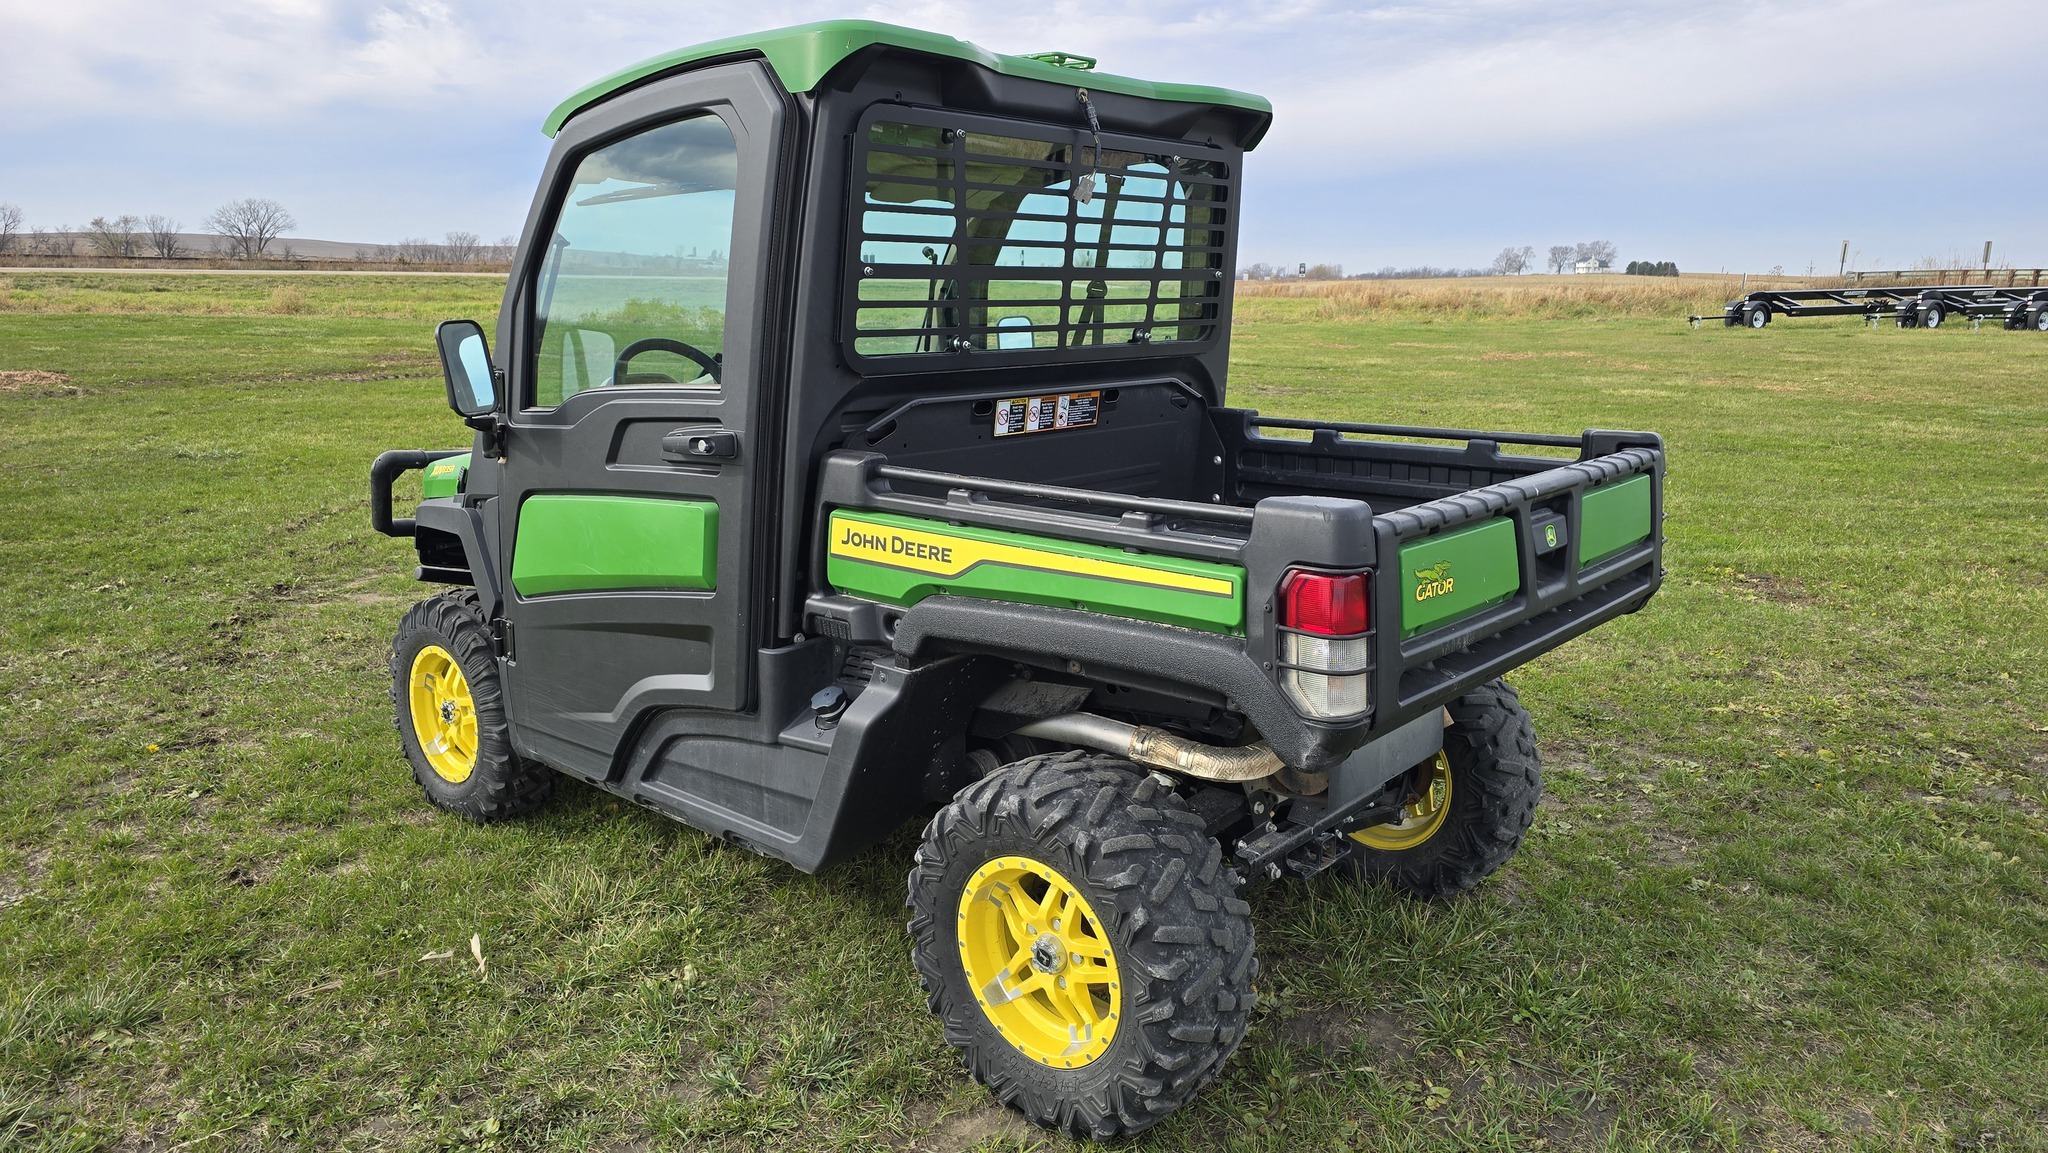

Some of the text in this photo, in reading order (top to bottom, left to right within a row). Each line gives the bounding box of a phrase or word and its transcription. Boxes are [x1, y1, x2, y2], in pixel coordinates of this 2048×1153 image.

[842, 528, 952, 563] JOHN DEERE
[1415, 577, 1454, 603] GATOR
